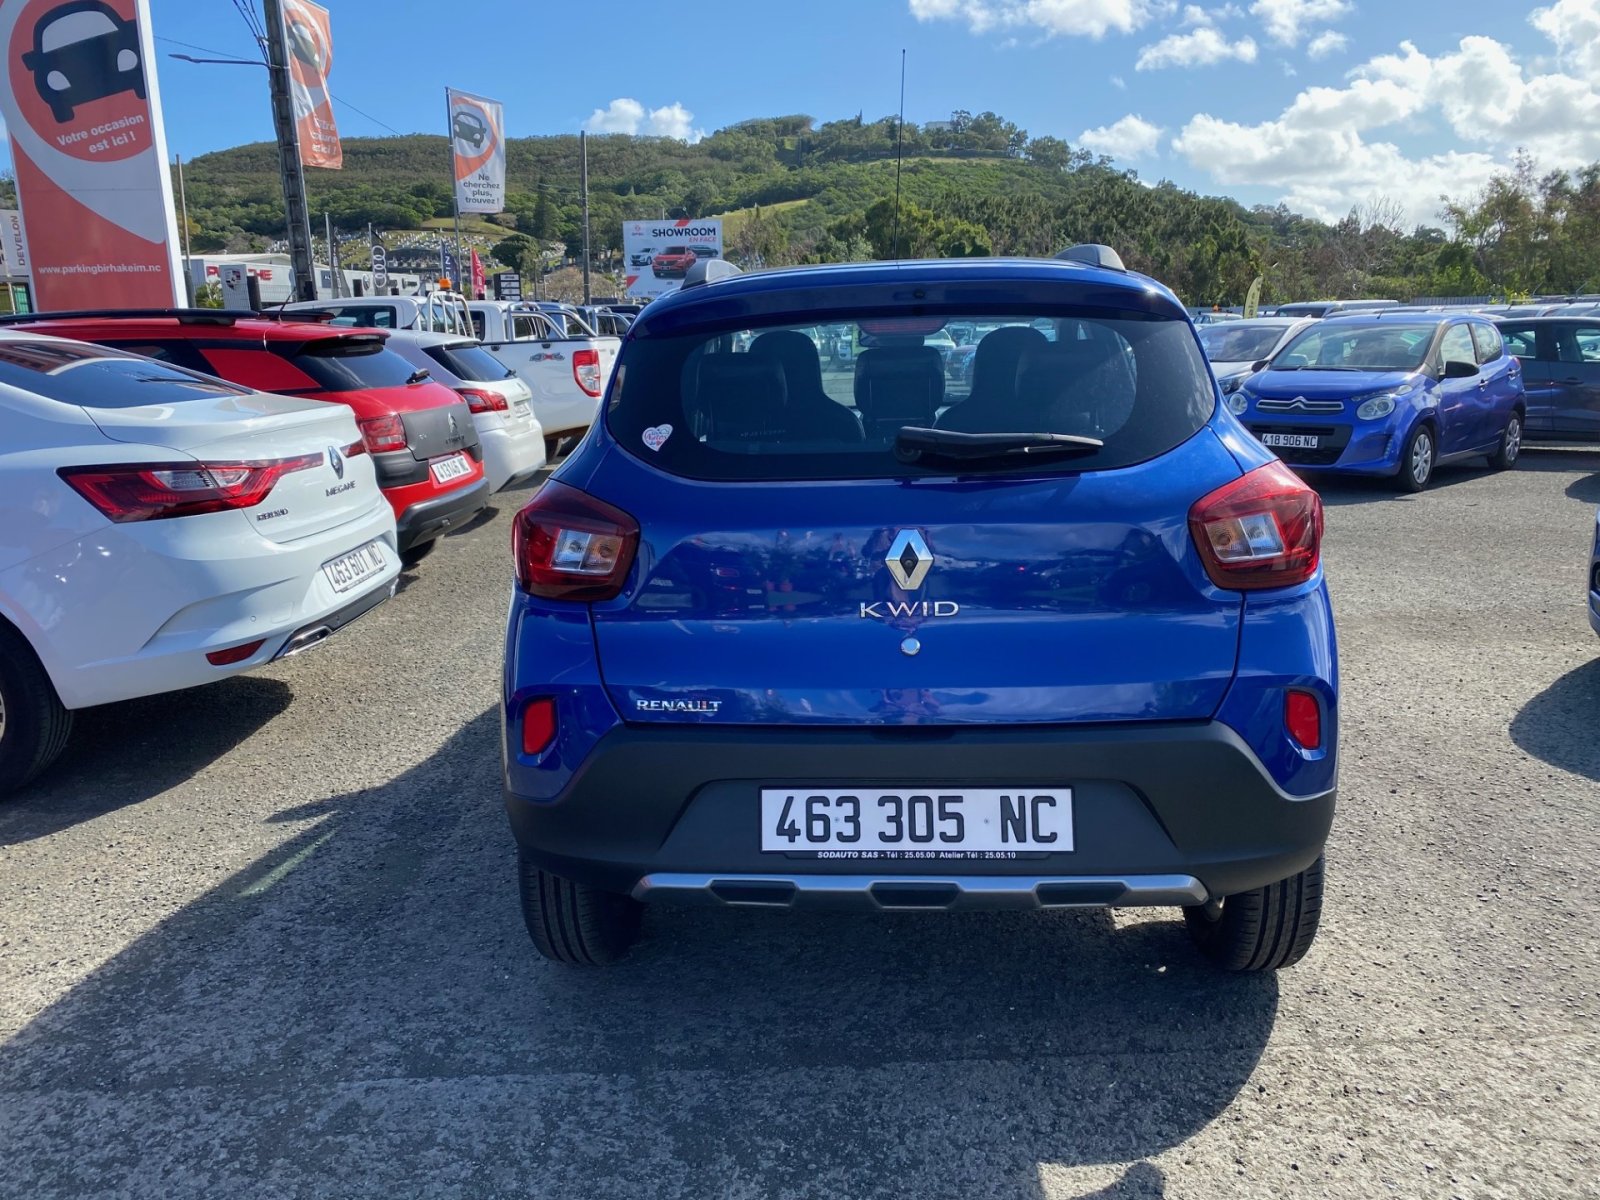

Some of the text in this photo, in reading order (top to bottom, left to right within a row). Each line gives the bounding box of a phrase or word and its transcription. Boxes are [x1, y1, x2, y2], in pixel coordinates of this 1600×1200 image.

[56, 114, 144, 146] Votre occasion
[89, 130, 136, 153] est ici !
[478, 173, 490, 181] Ne
[463, 181, 500, 189] cherchez
[472, 189, 492, 197] plus,
[465, 196, 495, 204] trouvez
[652, 227, 716, 237] SHOWROOM
[10, 215, 26, 266] DEVELON
[38, 263, 161, 275] www.parkingbirhakeim.nc
[1263, 434, 1316, 447] 418 906 NC
[329, 543, 383, 586] 463 601 NC
[860, 601, 959, 618] KWID
[636, 699, 722, 711] RENAULT
[776, 795, 1058, 843] 463 305 NC
[817, 851, 859, 859] SODAUTO
[860, 851, 879, 859] SAS
[904, 851, 936, 859] 25.05.00
[939, 851, 965, 859] Atelier
[985, 851, 1016, 859] 25.05.10
